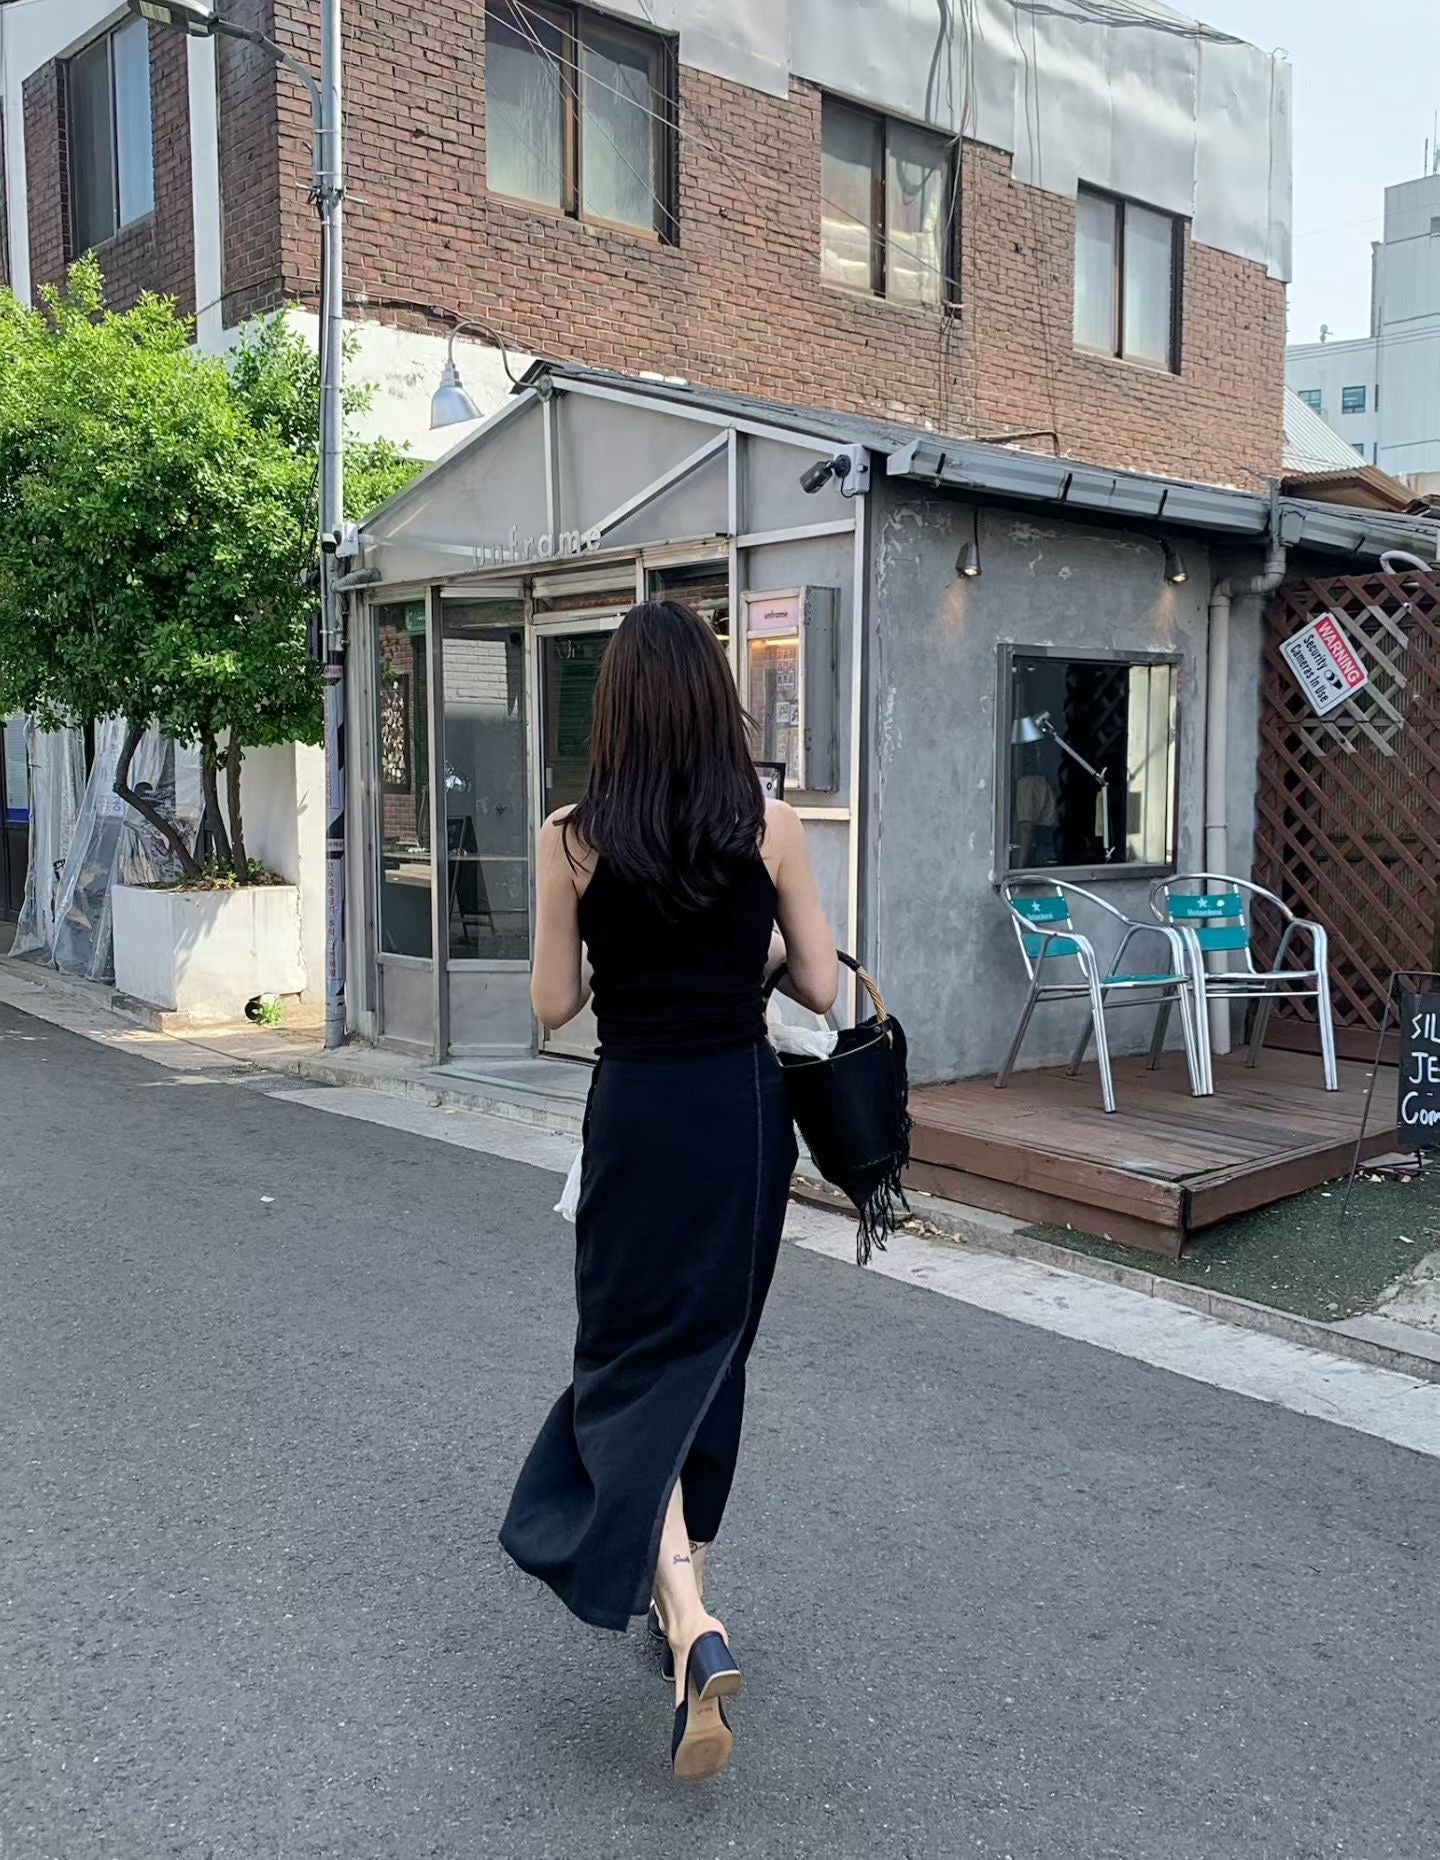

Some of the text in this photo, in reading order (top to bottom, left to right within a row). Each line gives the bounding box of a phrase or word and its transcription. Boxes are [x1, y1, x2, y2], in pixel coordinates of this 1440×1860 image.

[1303, 634, 1328, 671] Security
[1318, 621, 1360, 683] WARNING
[1290, 643, 1329, 703] Cameras In Use
[1411, 1012, 1440, 1044] SIL
[1409, 1052, 1440, 1084] JE
